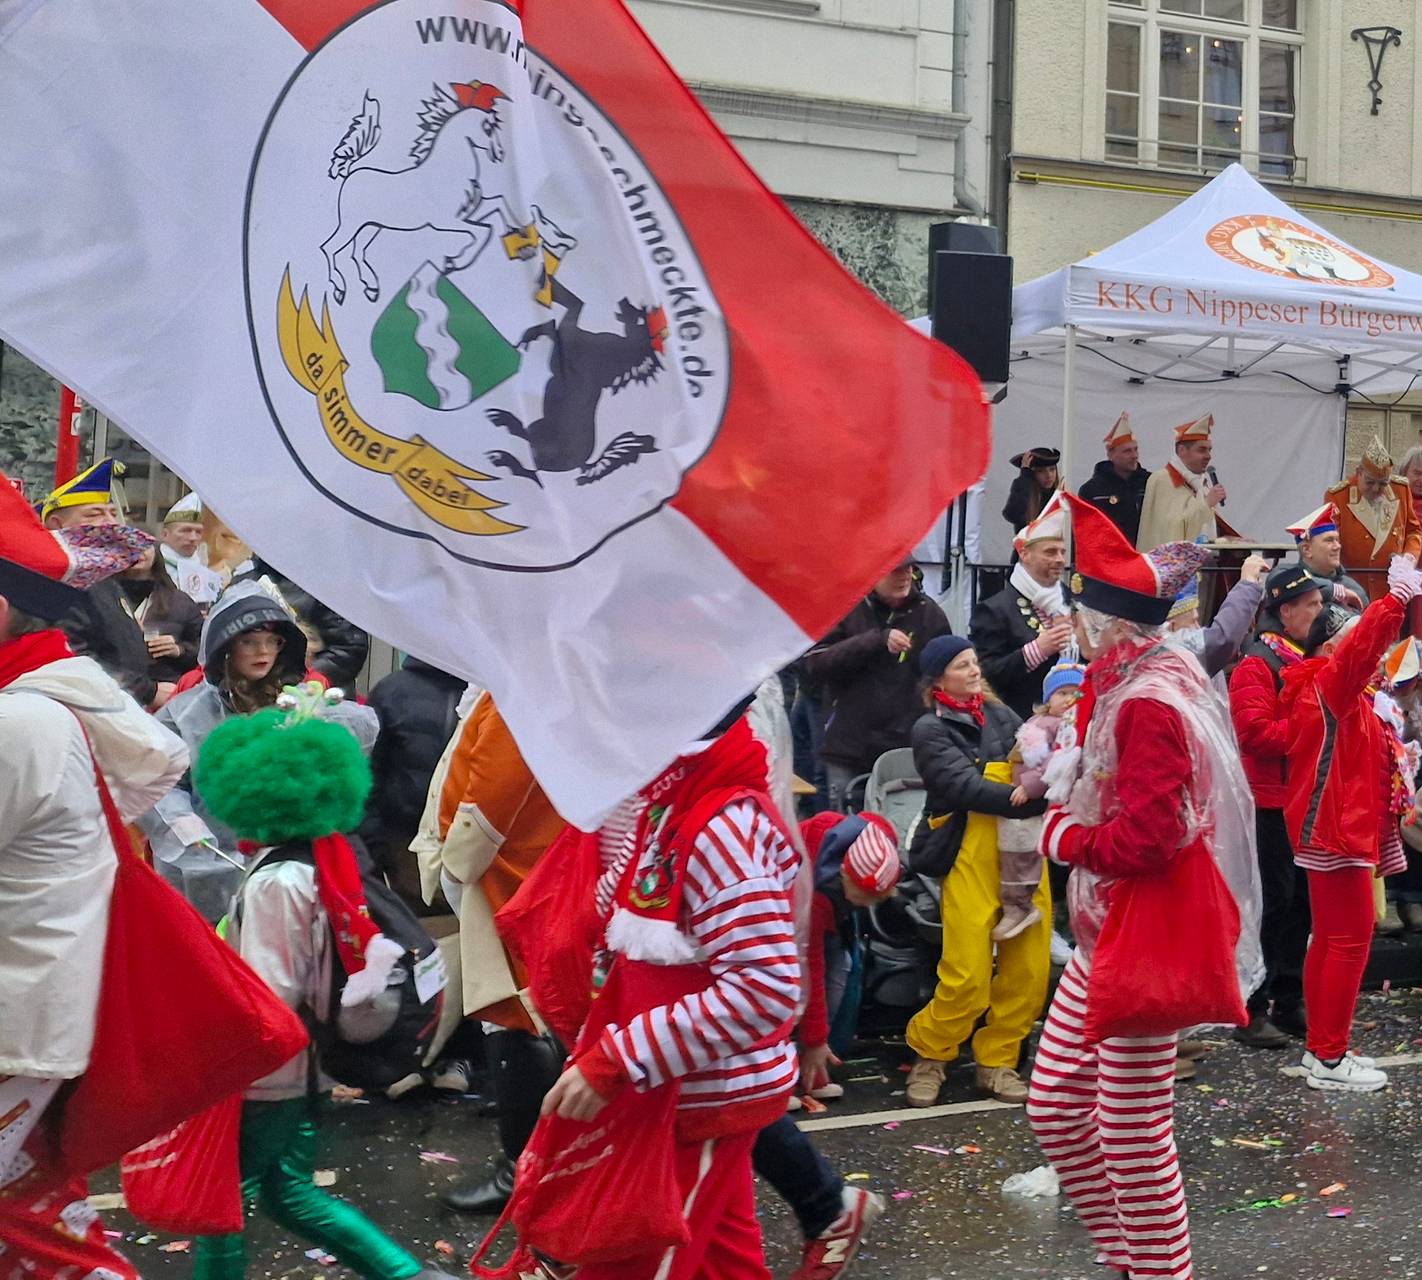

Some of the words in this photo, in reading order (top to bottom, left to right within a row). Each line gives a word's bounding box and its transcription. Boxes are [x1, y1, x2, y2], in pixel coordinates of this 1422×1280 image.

[1097, 280, 1173, 313] KKG
[1185, 288, 1309, 327] Nippeser
[306, 352, 324, 380] da
[324, 387, 398, 464] simmer
[408, 467, 470, 505] dabei
